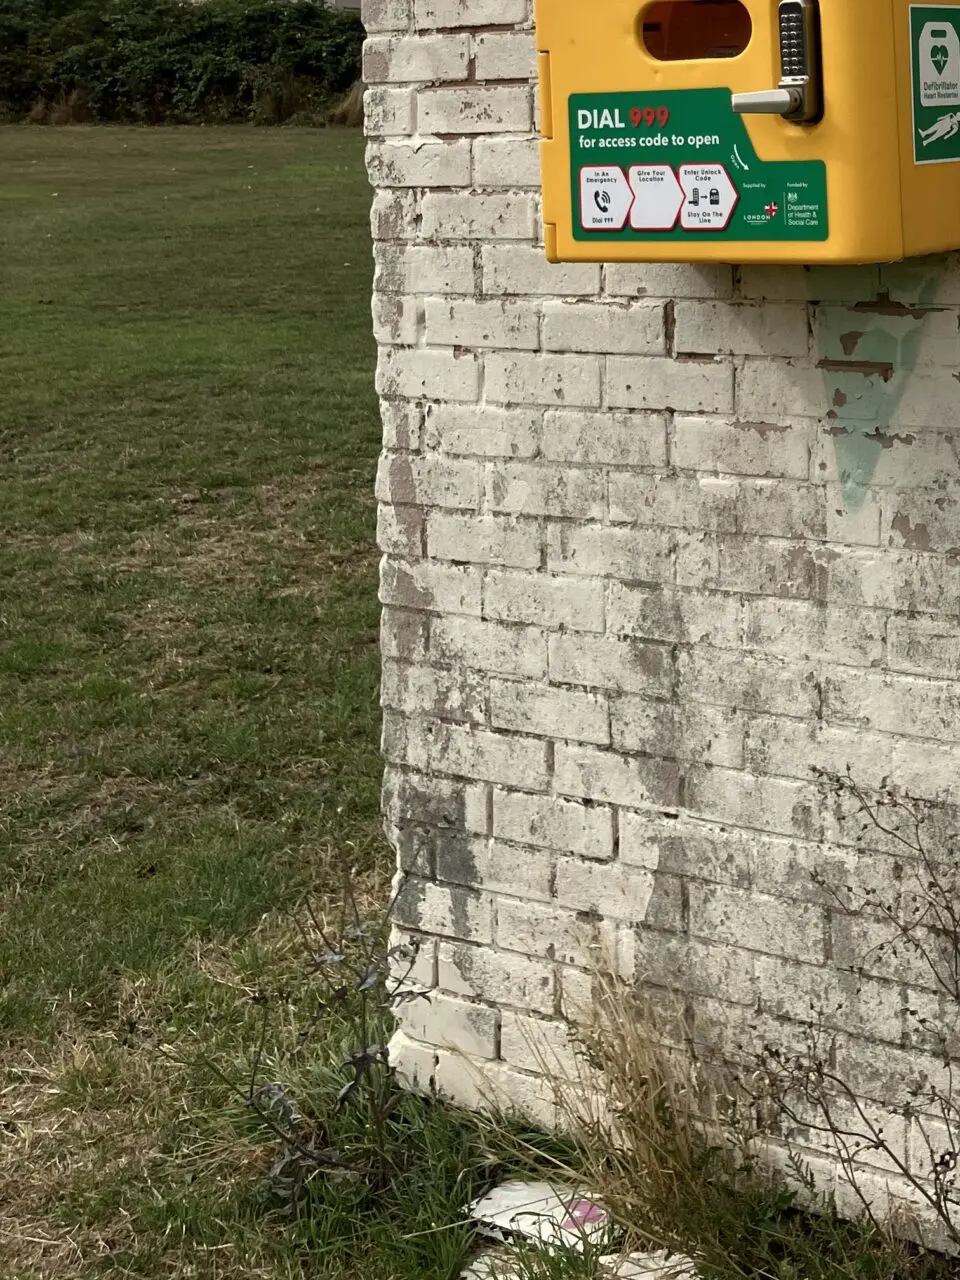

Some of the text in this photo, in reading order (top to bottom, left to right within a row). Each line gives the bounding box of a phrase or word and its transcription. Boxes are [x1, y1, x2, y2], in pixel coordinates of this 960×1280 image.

[923, 81, 958, 91] Defibrillator
[577, 107, 669, 129] DIAL 999
[579, 133, 720, 149] for access code to open
